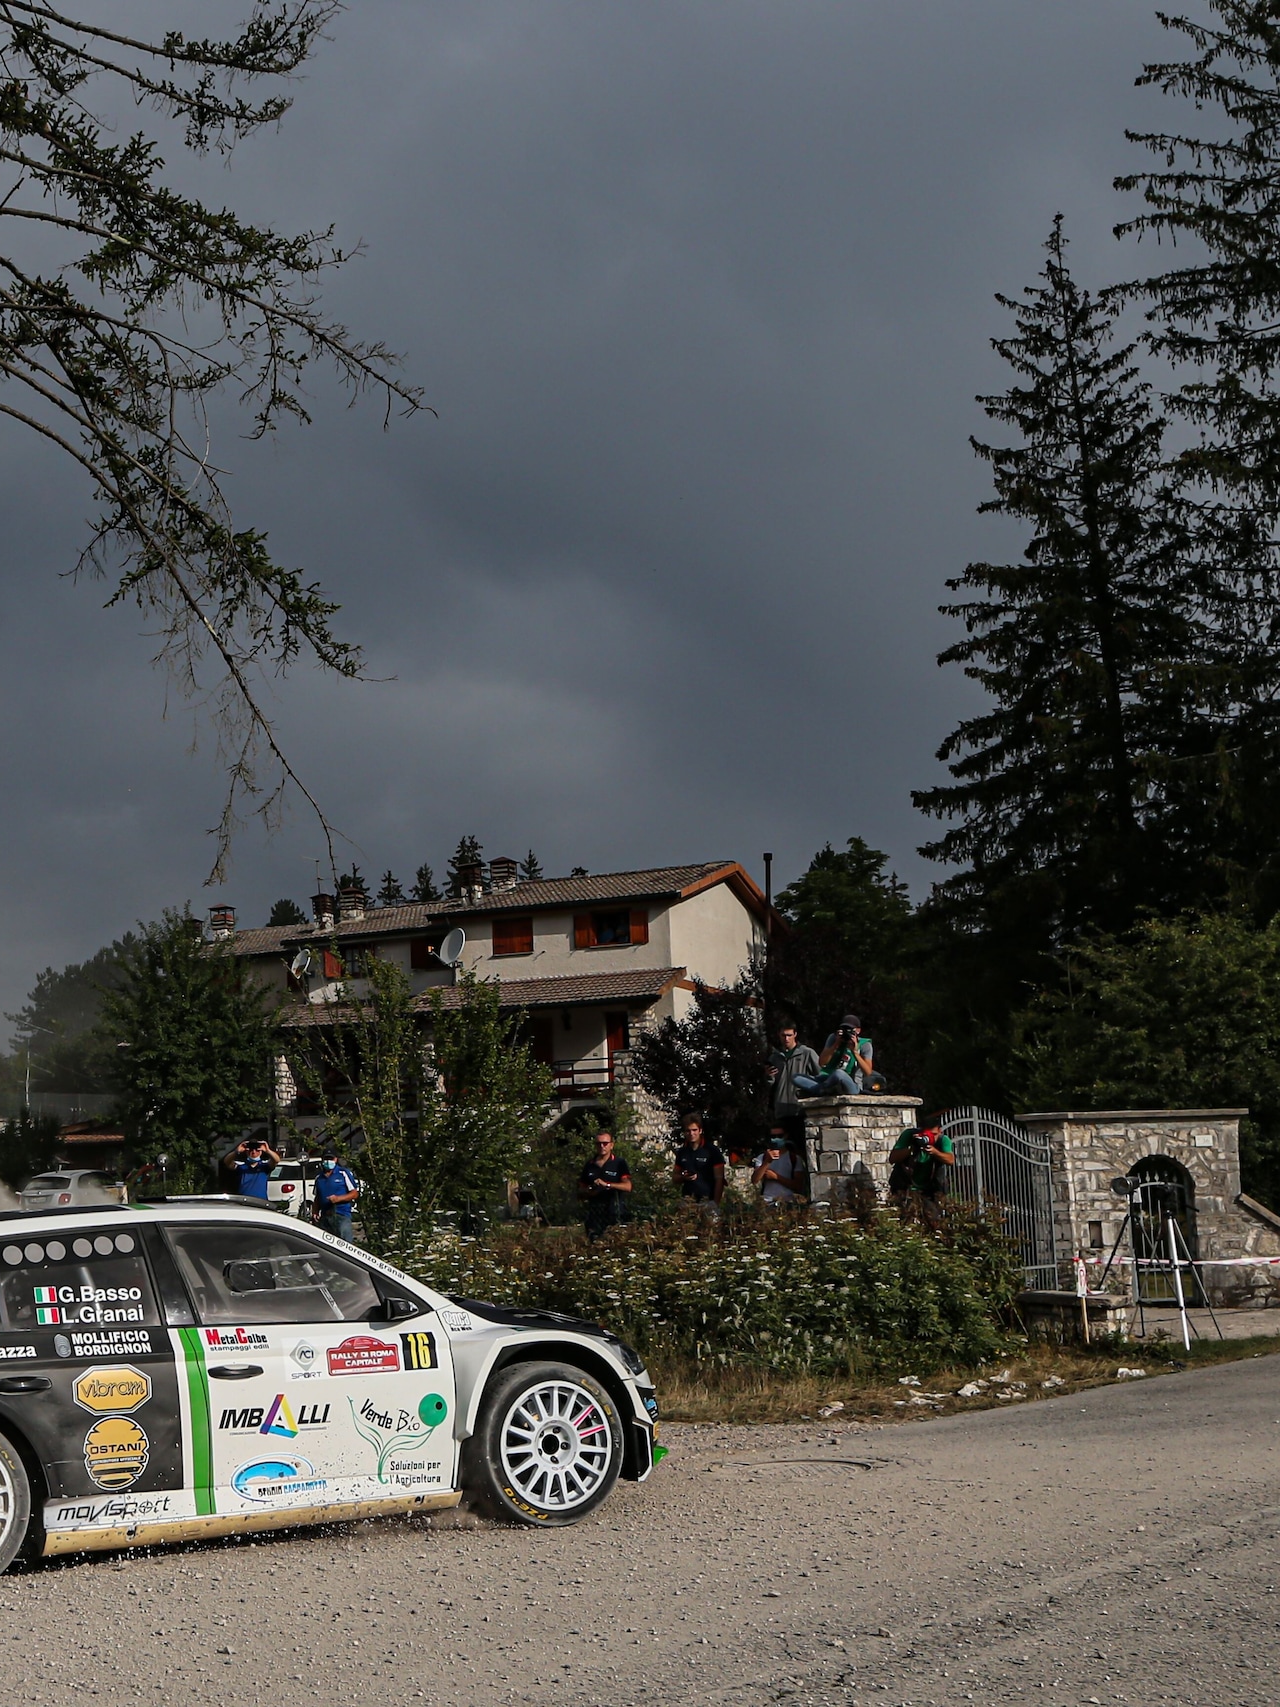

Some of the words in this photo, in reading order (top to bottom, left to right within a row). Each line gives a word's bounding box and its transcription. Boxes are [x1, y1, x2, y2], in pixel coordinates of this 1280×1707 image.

[336, 1239, 405, 1280] @lorenzo.granai
[58, 1285, 142, 1303] G.Basso
[61, 1304, 145, 1324] L.Granai
[71, 1330, 150, 1345] MOLLIFICIO
[74, 1342, 152, 1357] BORDIGNON
[210, 1344, 252, 1352] stampaggi
[299, 1350, 314, 1360] ACI
[407, 1332, 432, 1369] 16
[331, 1352, 358, 1360] RALLY
[345, 1358, 383, 1367] CAPITALE
[291, 1371, 322, 1380] SPORT
[80, 1379, 145, 1398] vibram
[219, 1394, 331, 1438] IMBALLI
[360, 1398, 393, 1429] Verde
[396, 1409, 421, 1432] Bio
[90, 1442, 141, 1455] OSTANI
[390, 1461, 425, 1471] Soluzioni
[427, 1462, 441, 1471] per
[389, 1475, 441, 1486] l'Agricoltura
